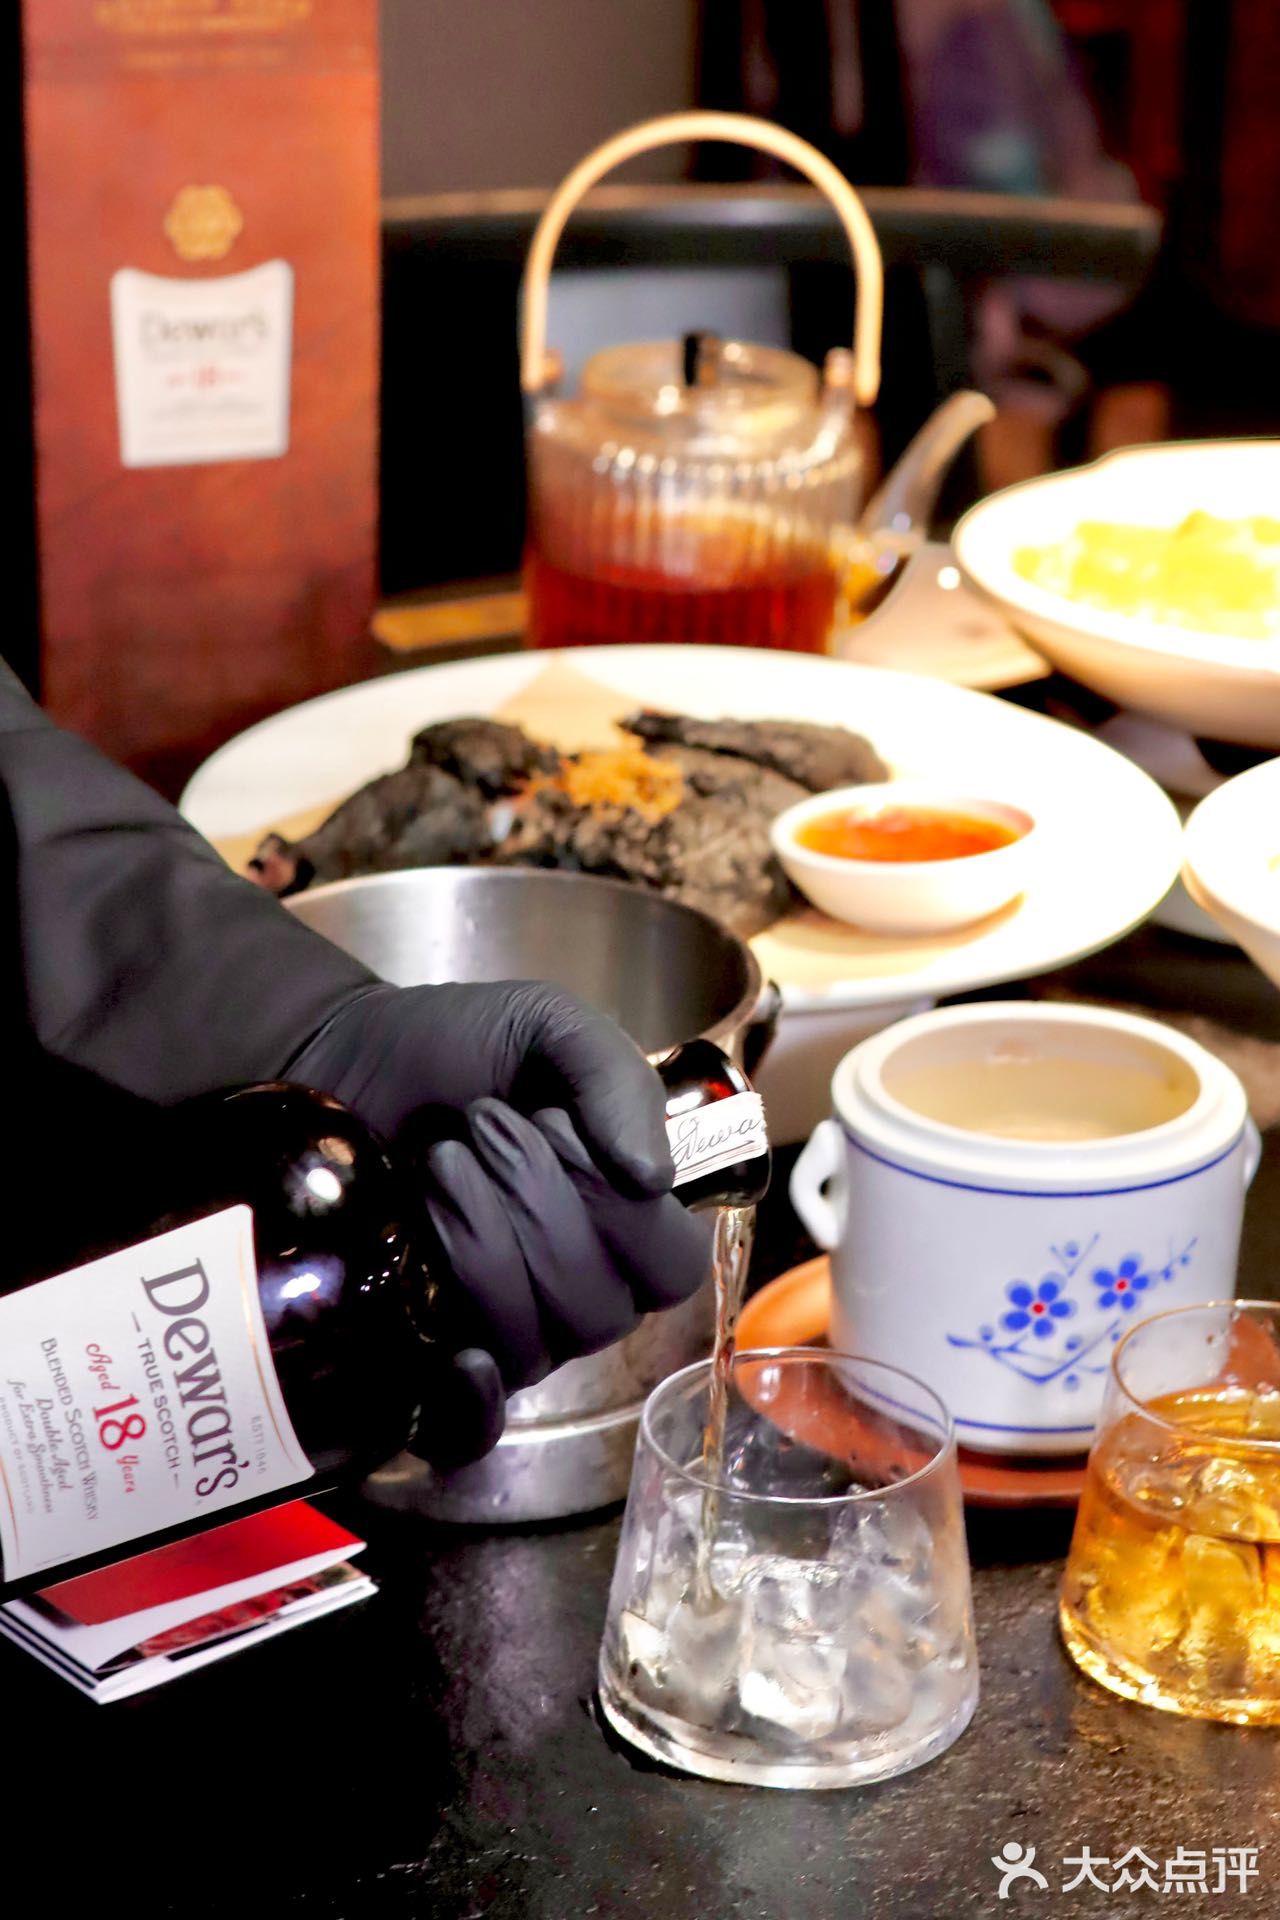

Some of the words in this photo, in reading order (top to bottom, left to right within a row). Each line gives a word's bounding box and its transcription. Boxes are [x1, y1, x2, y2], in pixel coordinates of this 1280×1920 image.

[86, 1343, 120, 1391] Aged
[140, 1257, 250, 1497] Dewar's
[7, 1378, 26, 1400] for
[19, 1403, 37, 1440] Extra
[92, 1392, 146, 1451] 18
[137, 1338, 164, 1393] TRUE
[154, 1394, 181, 1470] SCOTCH
[35, 1398, 63, 1454] Double
[50, 1454, 73, 1491] Aged
[116, 1454, 141, 1494] Years
